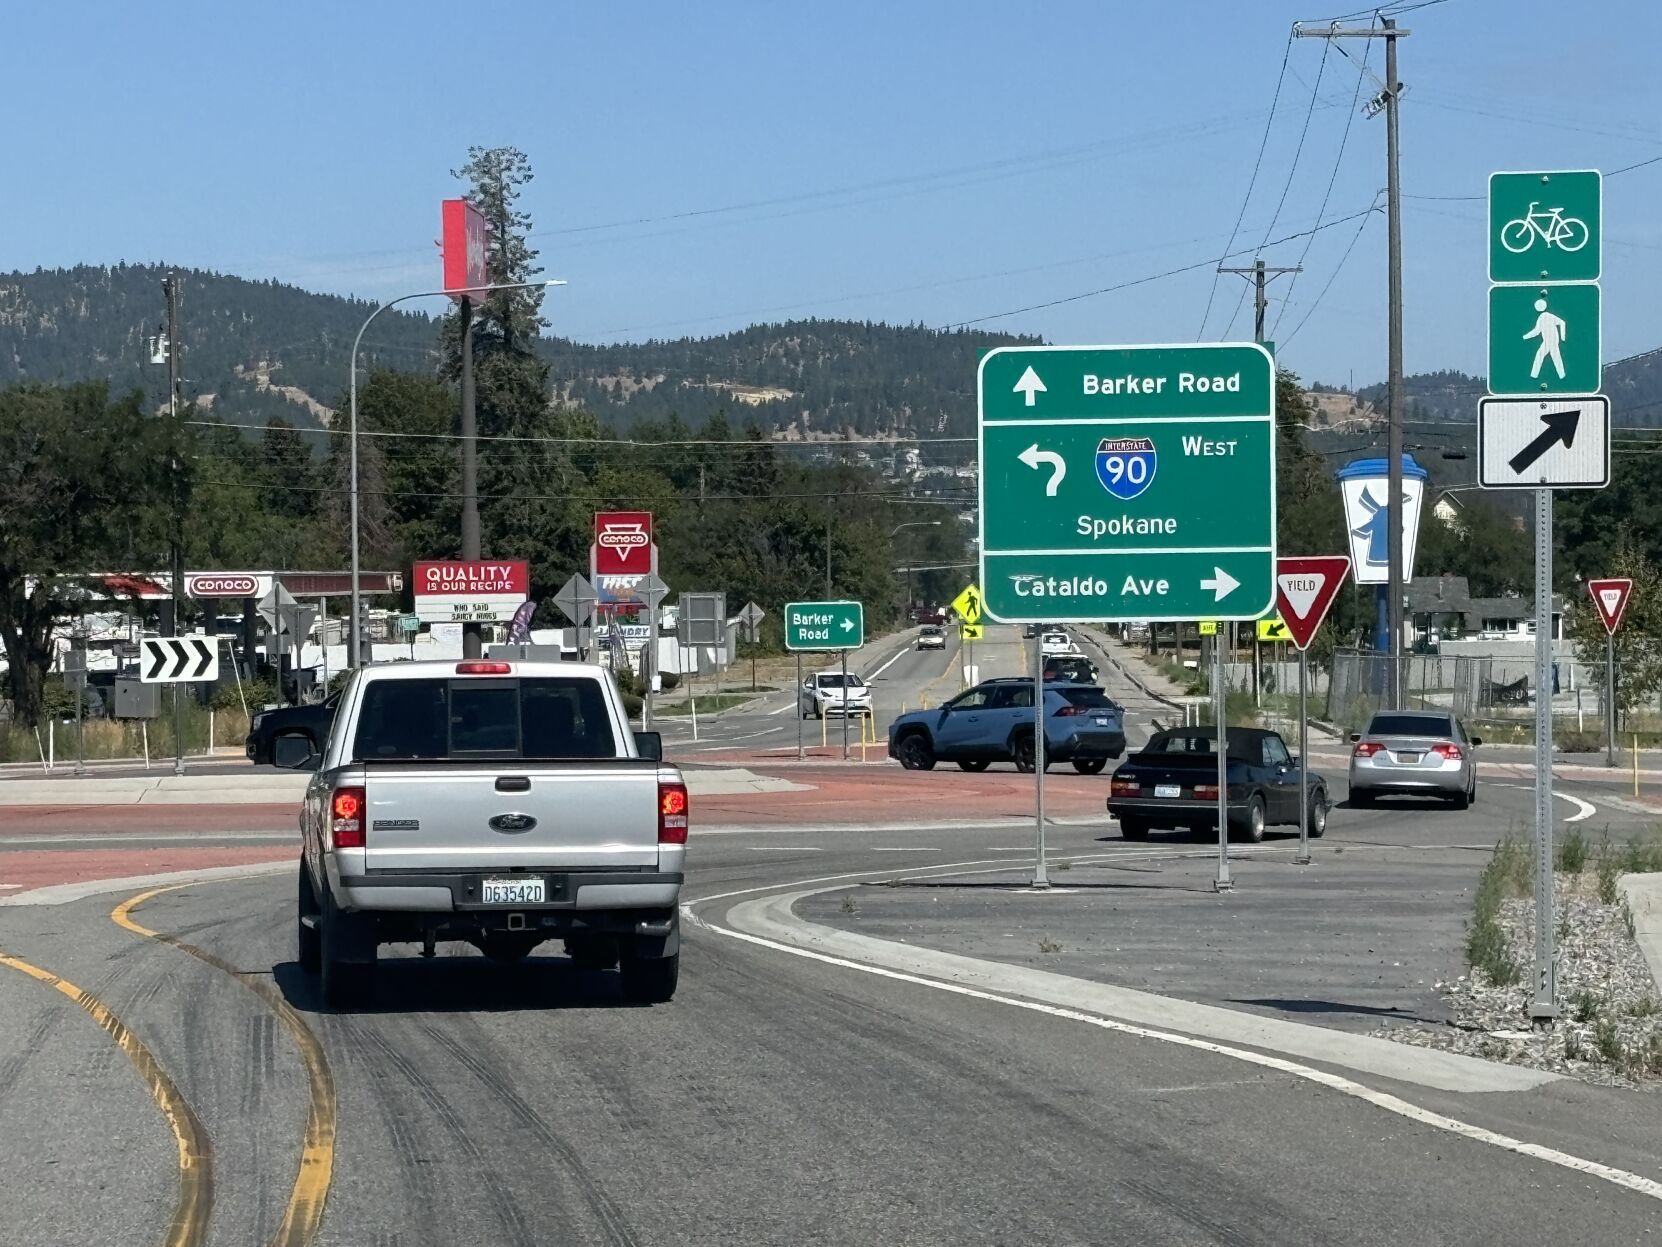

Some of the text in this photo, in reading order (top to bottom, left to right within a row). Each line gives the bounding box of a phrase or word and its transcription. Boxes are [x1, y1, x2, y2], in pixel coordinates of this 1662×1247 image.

[1082, 372, 1241, 395] Barker Road
[1104, 441, 1147, 451] INTERSTATE
[1105, 456, 1147, 485] 90
[1076, 514, 1178, 540] Spokane
[426, 566, 512, 582] QUALITY
[426, 581, 513, 591] IS OUR RECIPE
[1013, 575, 1170, 597] Cataldo Ave
[1287, 579, 1316, 592] YIELD
[453, 603, 489, 613] WHO SAID
[793, 613, 833, 625] Barker
[799, 628, 829, 640] Road
[484, 885, 542, 903] D63542D
